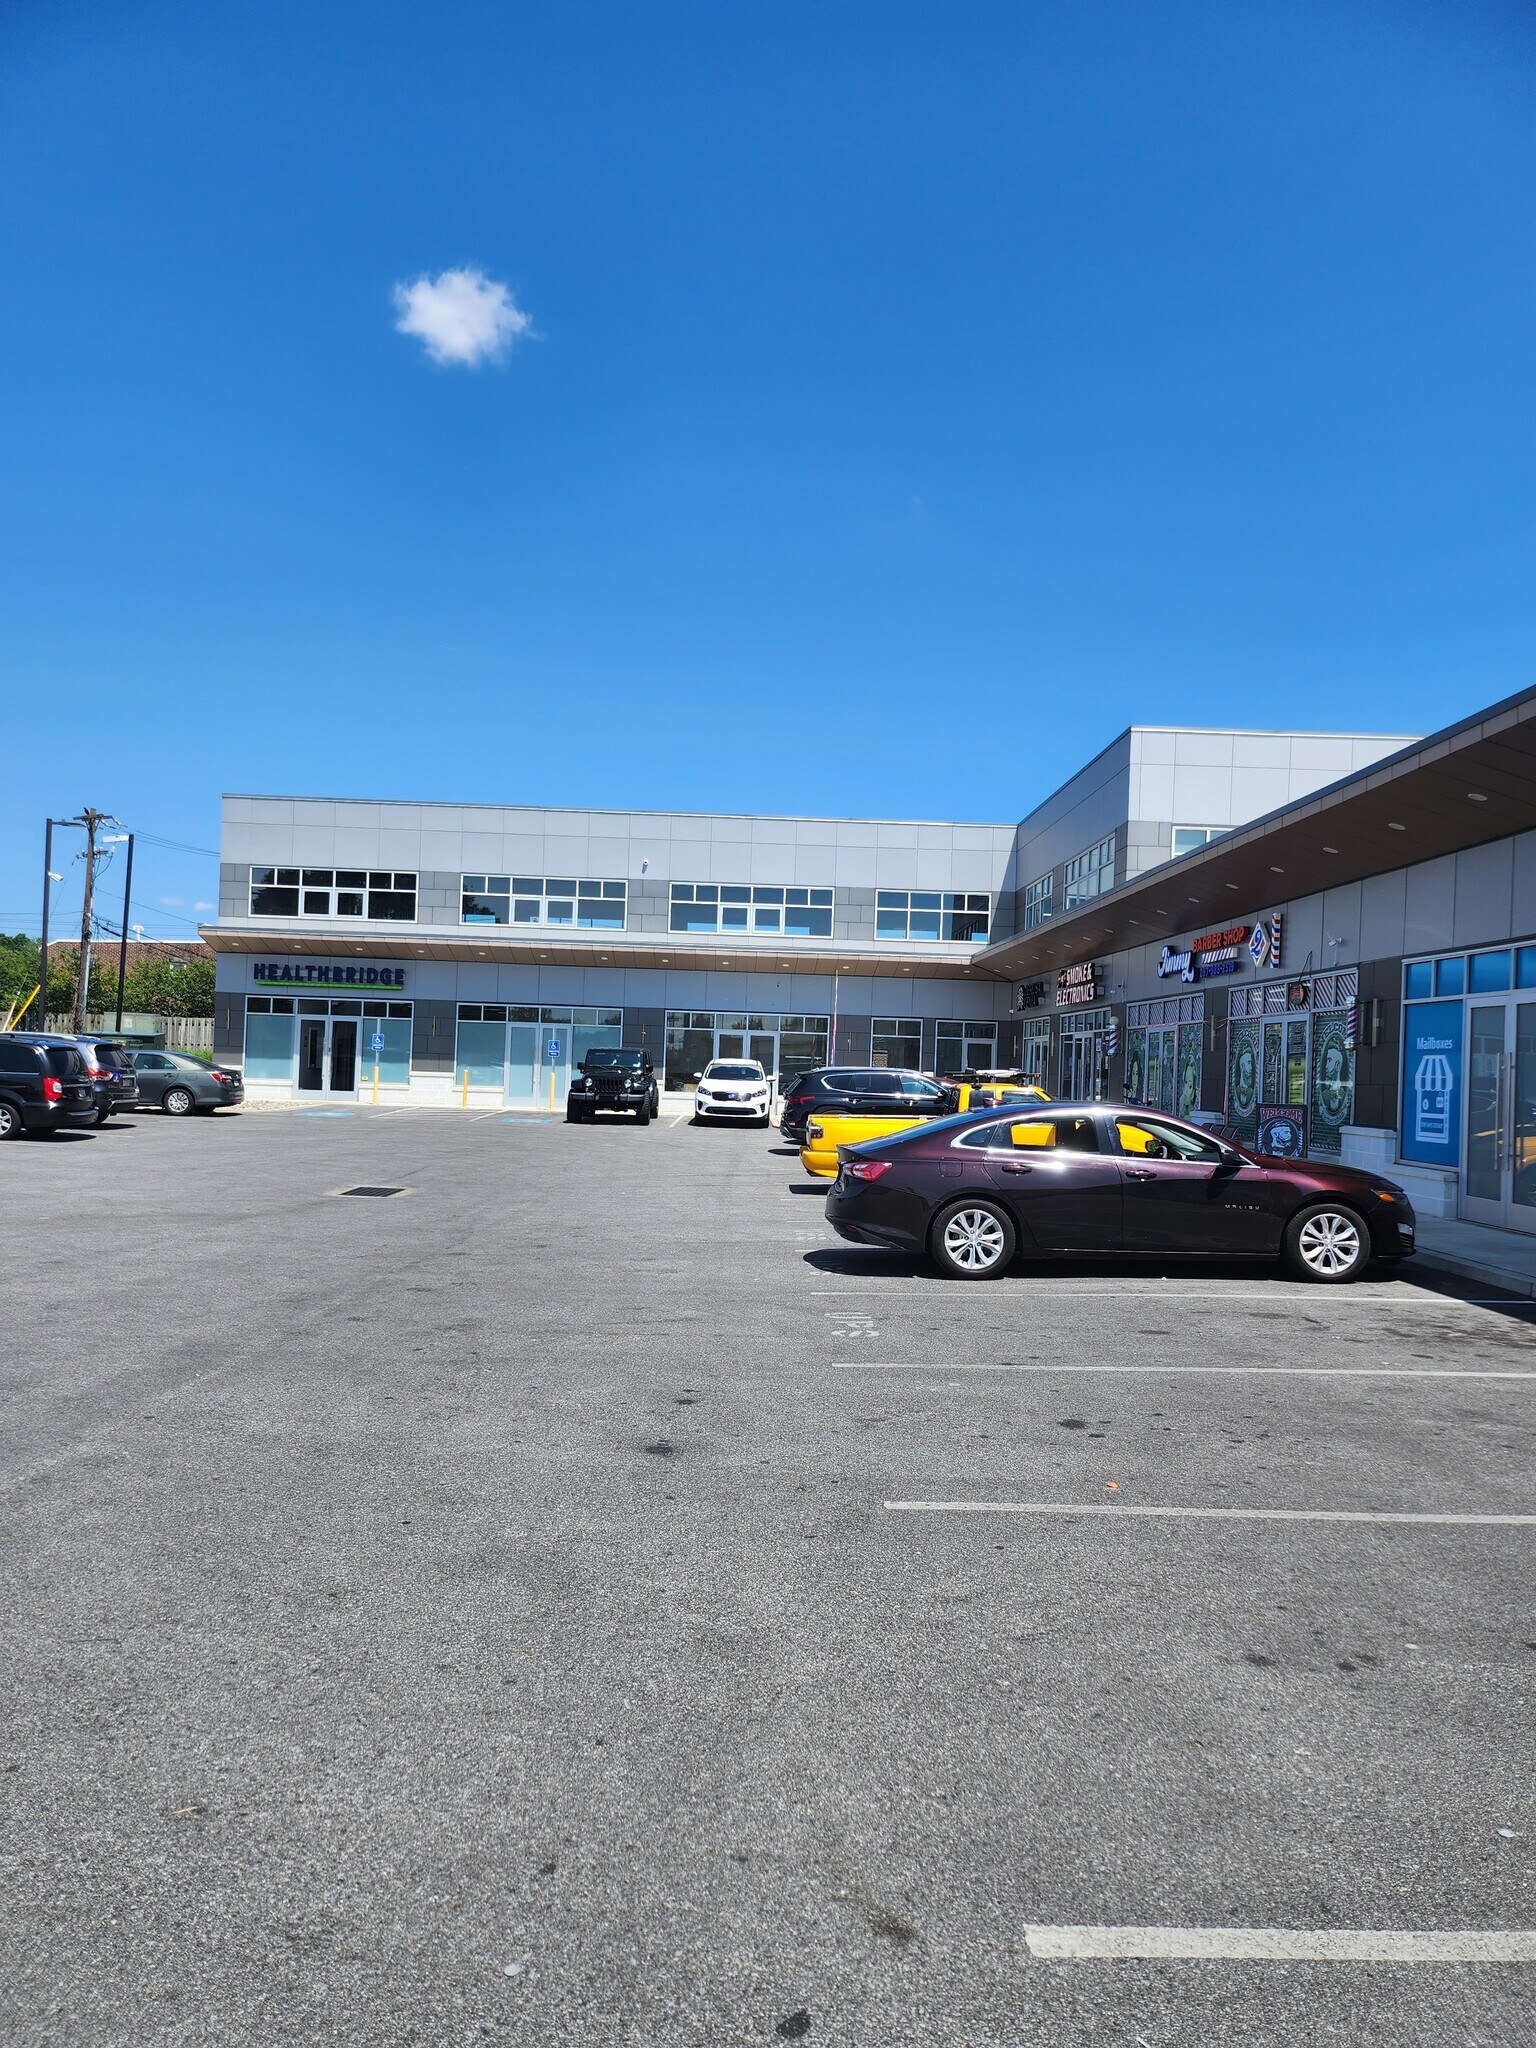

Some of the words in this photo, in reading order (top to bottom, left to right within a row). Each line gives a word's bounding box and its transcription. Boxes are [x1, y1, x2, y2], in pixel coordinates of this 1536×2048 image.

[1192, 932, 1222, 953] BARBER
[1223, 926, 1246, 945] SHOP
[253, 963, 405, 985] HEALTHBRIDGE
[1066, 964, 1087, 986] SMOKE
[1157, 945, 1195, 983] Jimmy
[1056, 982, 1095, 1007] ELECTRONICS
[1416, 1037, 1453, 1050] Mailboxes
[1260, 1108, 1303, 1124] WELCOME
